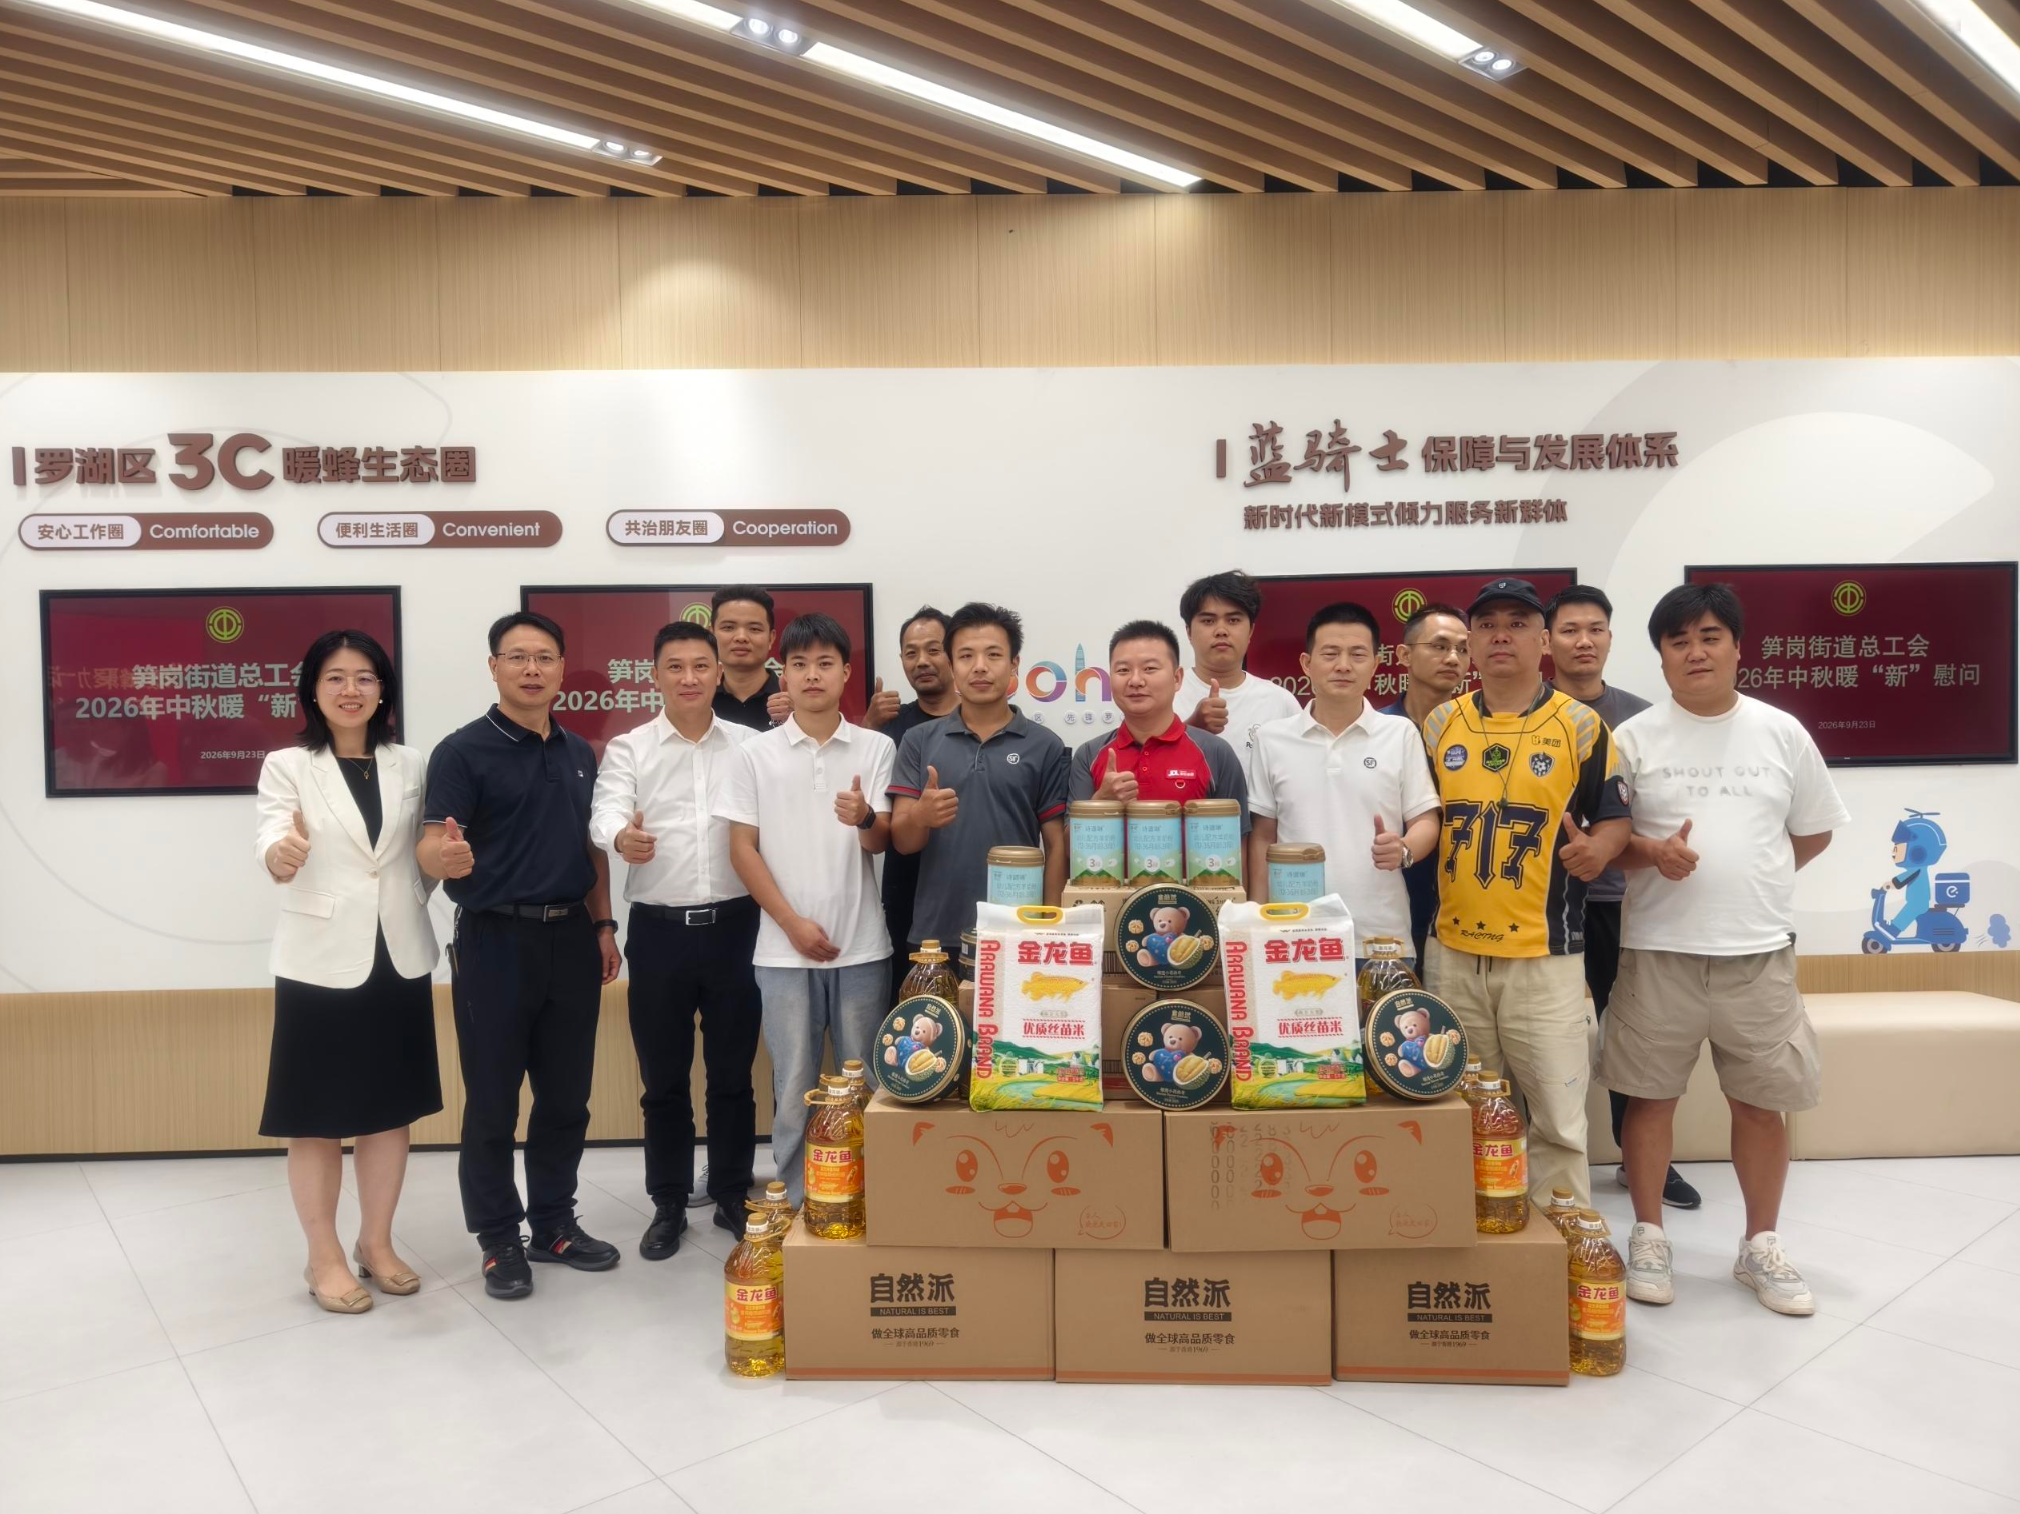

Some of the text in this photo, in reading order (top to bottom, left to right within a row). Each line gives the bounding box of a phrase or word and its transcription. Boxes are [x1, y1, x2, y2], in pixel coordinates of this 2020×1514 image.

[1421, 432, 1679, 473] 保障与发展体系
[35, 432, 476, 491] 罗湖区 3C 暖蜂生态圈
[1243, 499, 1568, 530] 新时代新模式倾力服务新群体
[37, 523, 125, 541] 安心工作圈
[150, 523, 260, 540] Comfortable
[335, 522, 418, 538] 便利生活圈
[442, 522, 540, 537] Convenient
[625, 520, 708, 537] 共治朋友圈
[732, 520, 838, 538] Cooperation
[1761, 633, 1930, 659] 笋岗街道总工会
[1818, 720, 1876, 730] 2026年9月23日
[200, 750, 265, 760] 2026年9月23日
[1662, 766, 1771, 778] SHOUT OUT
[1686, 785, 1753, 797] TO ALL
[1443, 799, 1549, 889] 717
[1460, 929, 1504, 942] RACING
[1017, 940, 1094, 966] 金龙鱼
[1264, 937, 1346, 964] 金龙鱼
[976, 940, 1001, 1079] ARAWANA BRAND
[1225, 941, 1254, 1082] ARAWANA BRAND
[1023, 1021, 1085, 1036] 优质丝苗米
[1278, 1020, 1343, 1036] 优质丝苗米
[813, 1149, 852, 1163] 金龙鱼
[1473, 1143, 1513, 1157] 金龙鱼
[736, 1287, 778, 1301] 金龙鱼
[870, 1272, 955, 1303] 自然派
[1144, 1277, 1231, 1308] 自然派
[1407, 1281, 1491, 1310] 自然派
[1577, 1285, 1619, 1300] 金龙鱼
[880, 1307, 949, 1316] NATURAL IS BEST
[1153, 1312, 1224, 1320] NATURAL IS BEST
[1416, 1313, 1453, 1321] NATURAL
[1464, 1314, 1485, 1322] BEST
[871, 1327, 960, 1340] 做全球高品质零食
[1144, 1332, 1235, 1345] 做全球高品质零食
[1409, 1329, 1490, 1341] 做全球高品质零食
